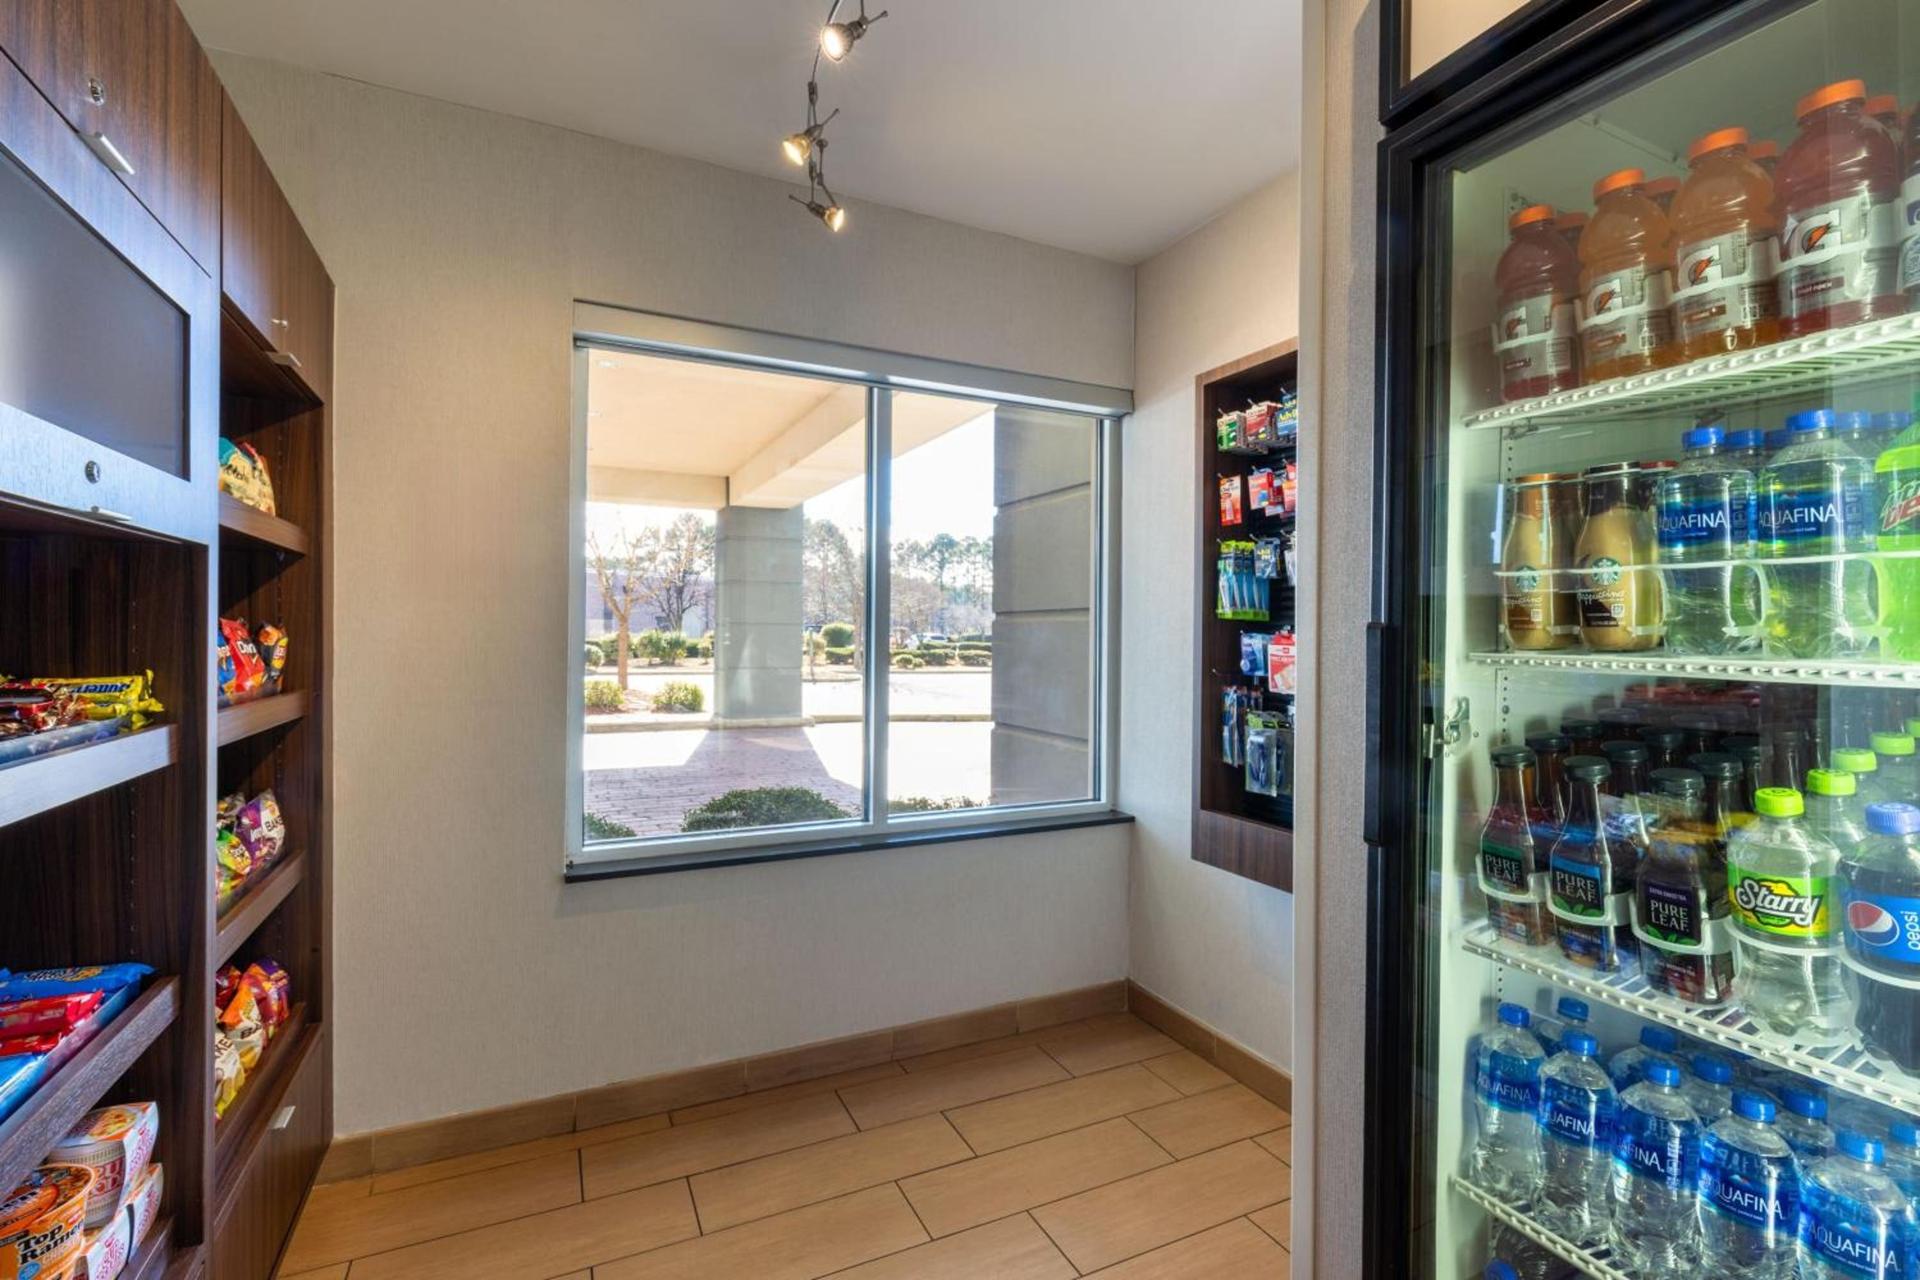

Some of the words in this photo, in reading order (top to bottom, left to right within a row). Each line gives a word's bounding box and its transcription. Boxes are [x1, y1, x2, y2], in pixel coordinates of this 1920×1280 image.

[1658, 510, 1728, 533] AQUAFINA
[1758, 503, 1841, 530] AQUAFINA
[1484, 854, 1520, 872] PURE
[1486, 864, 1520, 881] LEAF
[1555, 871, 1596, 890] PURE
[1556, 880, 1596, 902] LEAF
[1650, 899, 1689, 920] PURE
[1735, 878, 1820, 926] Starry
[1651, 911, 1690, 932] LEAF
[17, 1223, 65, 1252] Top
[1808, 1220, 1902, 1272] AQUAFINA
